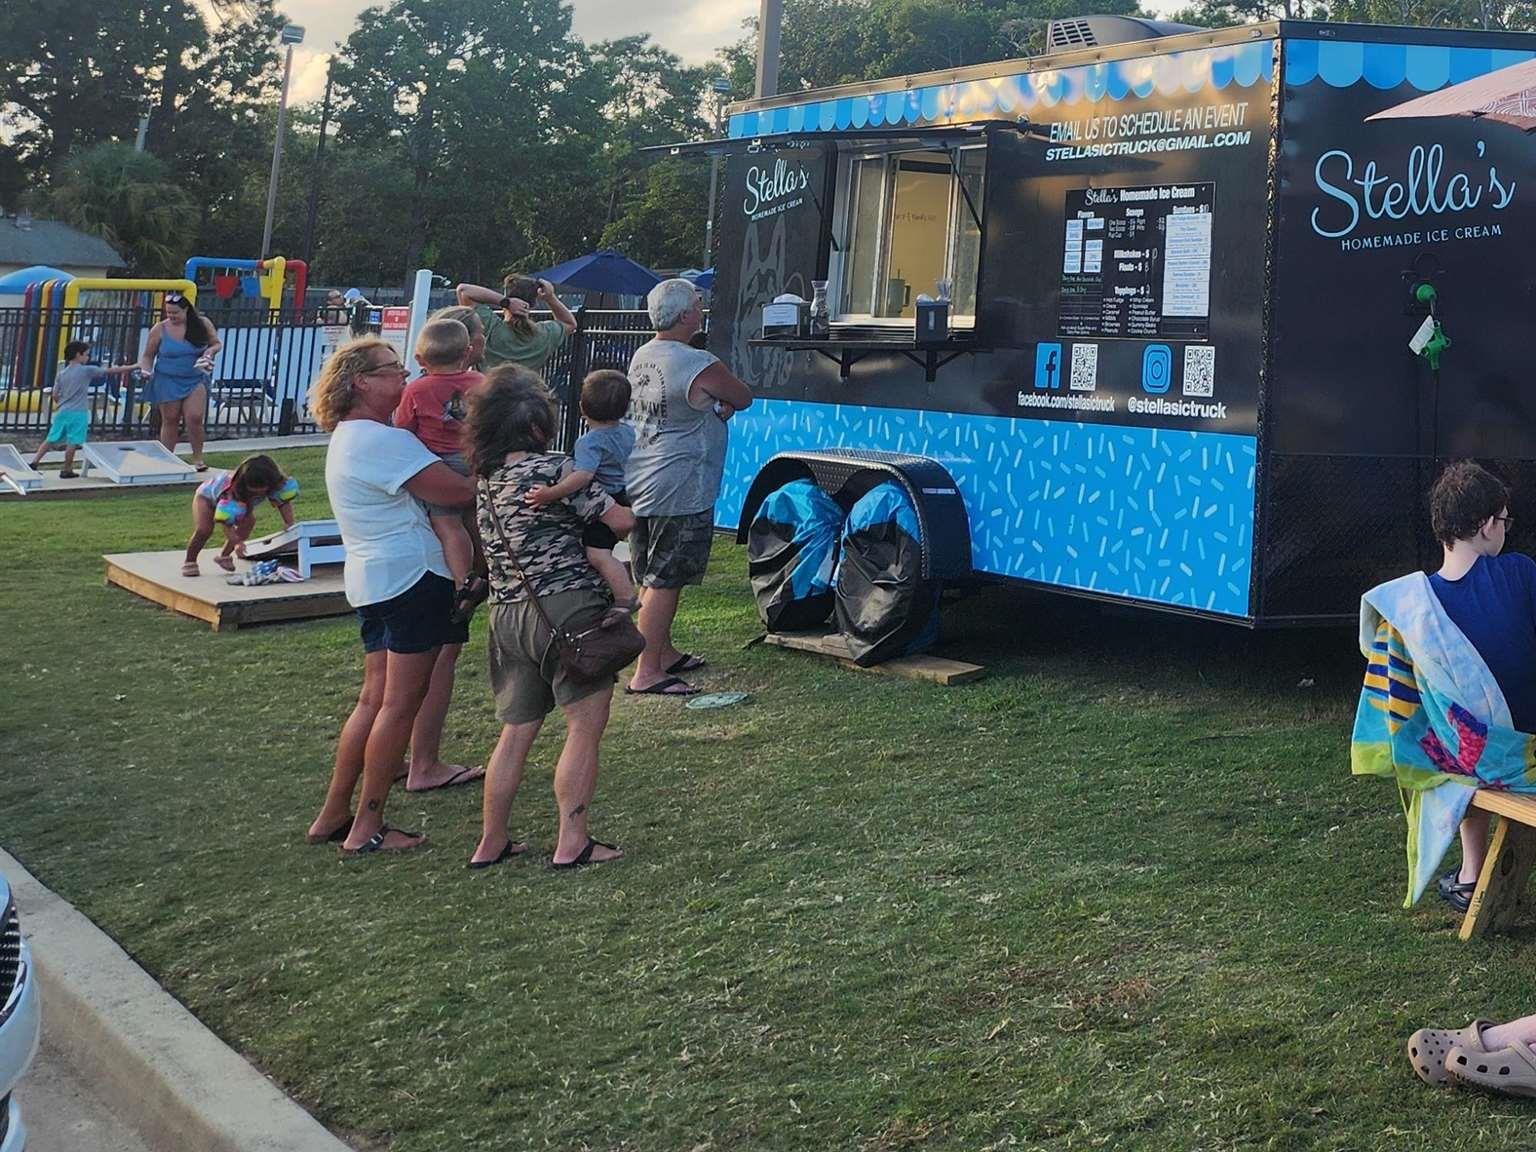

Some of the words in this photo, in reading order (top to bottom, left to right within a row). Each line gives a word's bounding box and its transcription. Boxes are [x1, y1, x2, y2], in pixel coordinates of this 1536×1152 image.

[1049, 121, 1082, 143] EMAIL
[1085, 118, 1100, 140] US
[1102, 116, 1118, 138] TO
[1118, 108, 1182, 136] SCHEDULE
[1183, 106, 1202, 130] AN
[1204, 102, 1249, 129] EVENT
[1045, 132, 1251, 161] STELLASICTRUCK@GMAIL.COM
[743, 158, 810, 215] Stella's
[1085, 188, 1119, 206] Stella's
[1120, 188, 1158, 202] Homemade
[1159, 187, 1171, 199] Ice
[1171, 186, 1195, 198] Cream
[1311, 140, 1516, 238] Stella's
[1341, 232, 1422, 251] HOMEMADE
[1427, 229, 1449, 242] ICE
[1455, 224, 1502, 239] CREAM
[1017, 391, 1115, 412] facebook.com/stellasictruck
[1127, 396, 1227, 419] @stellasictruck
